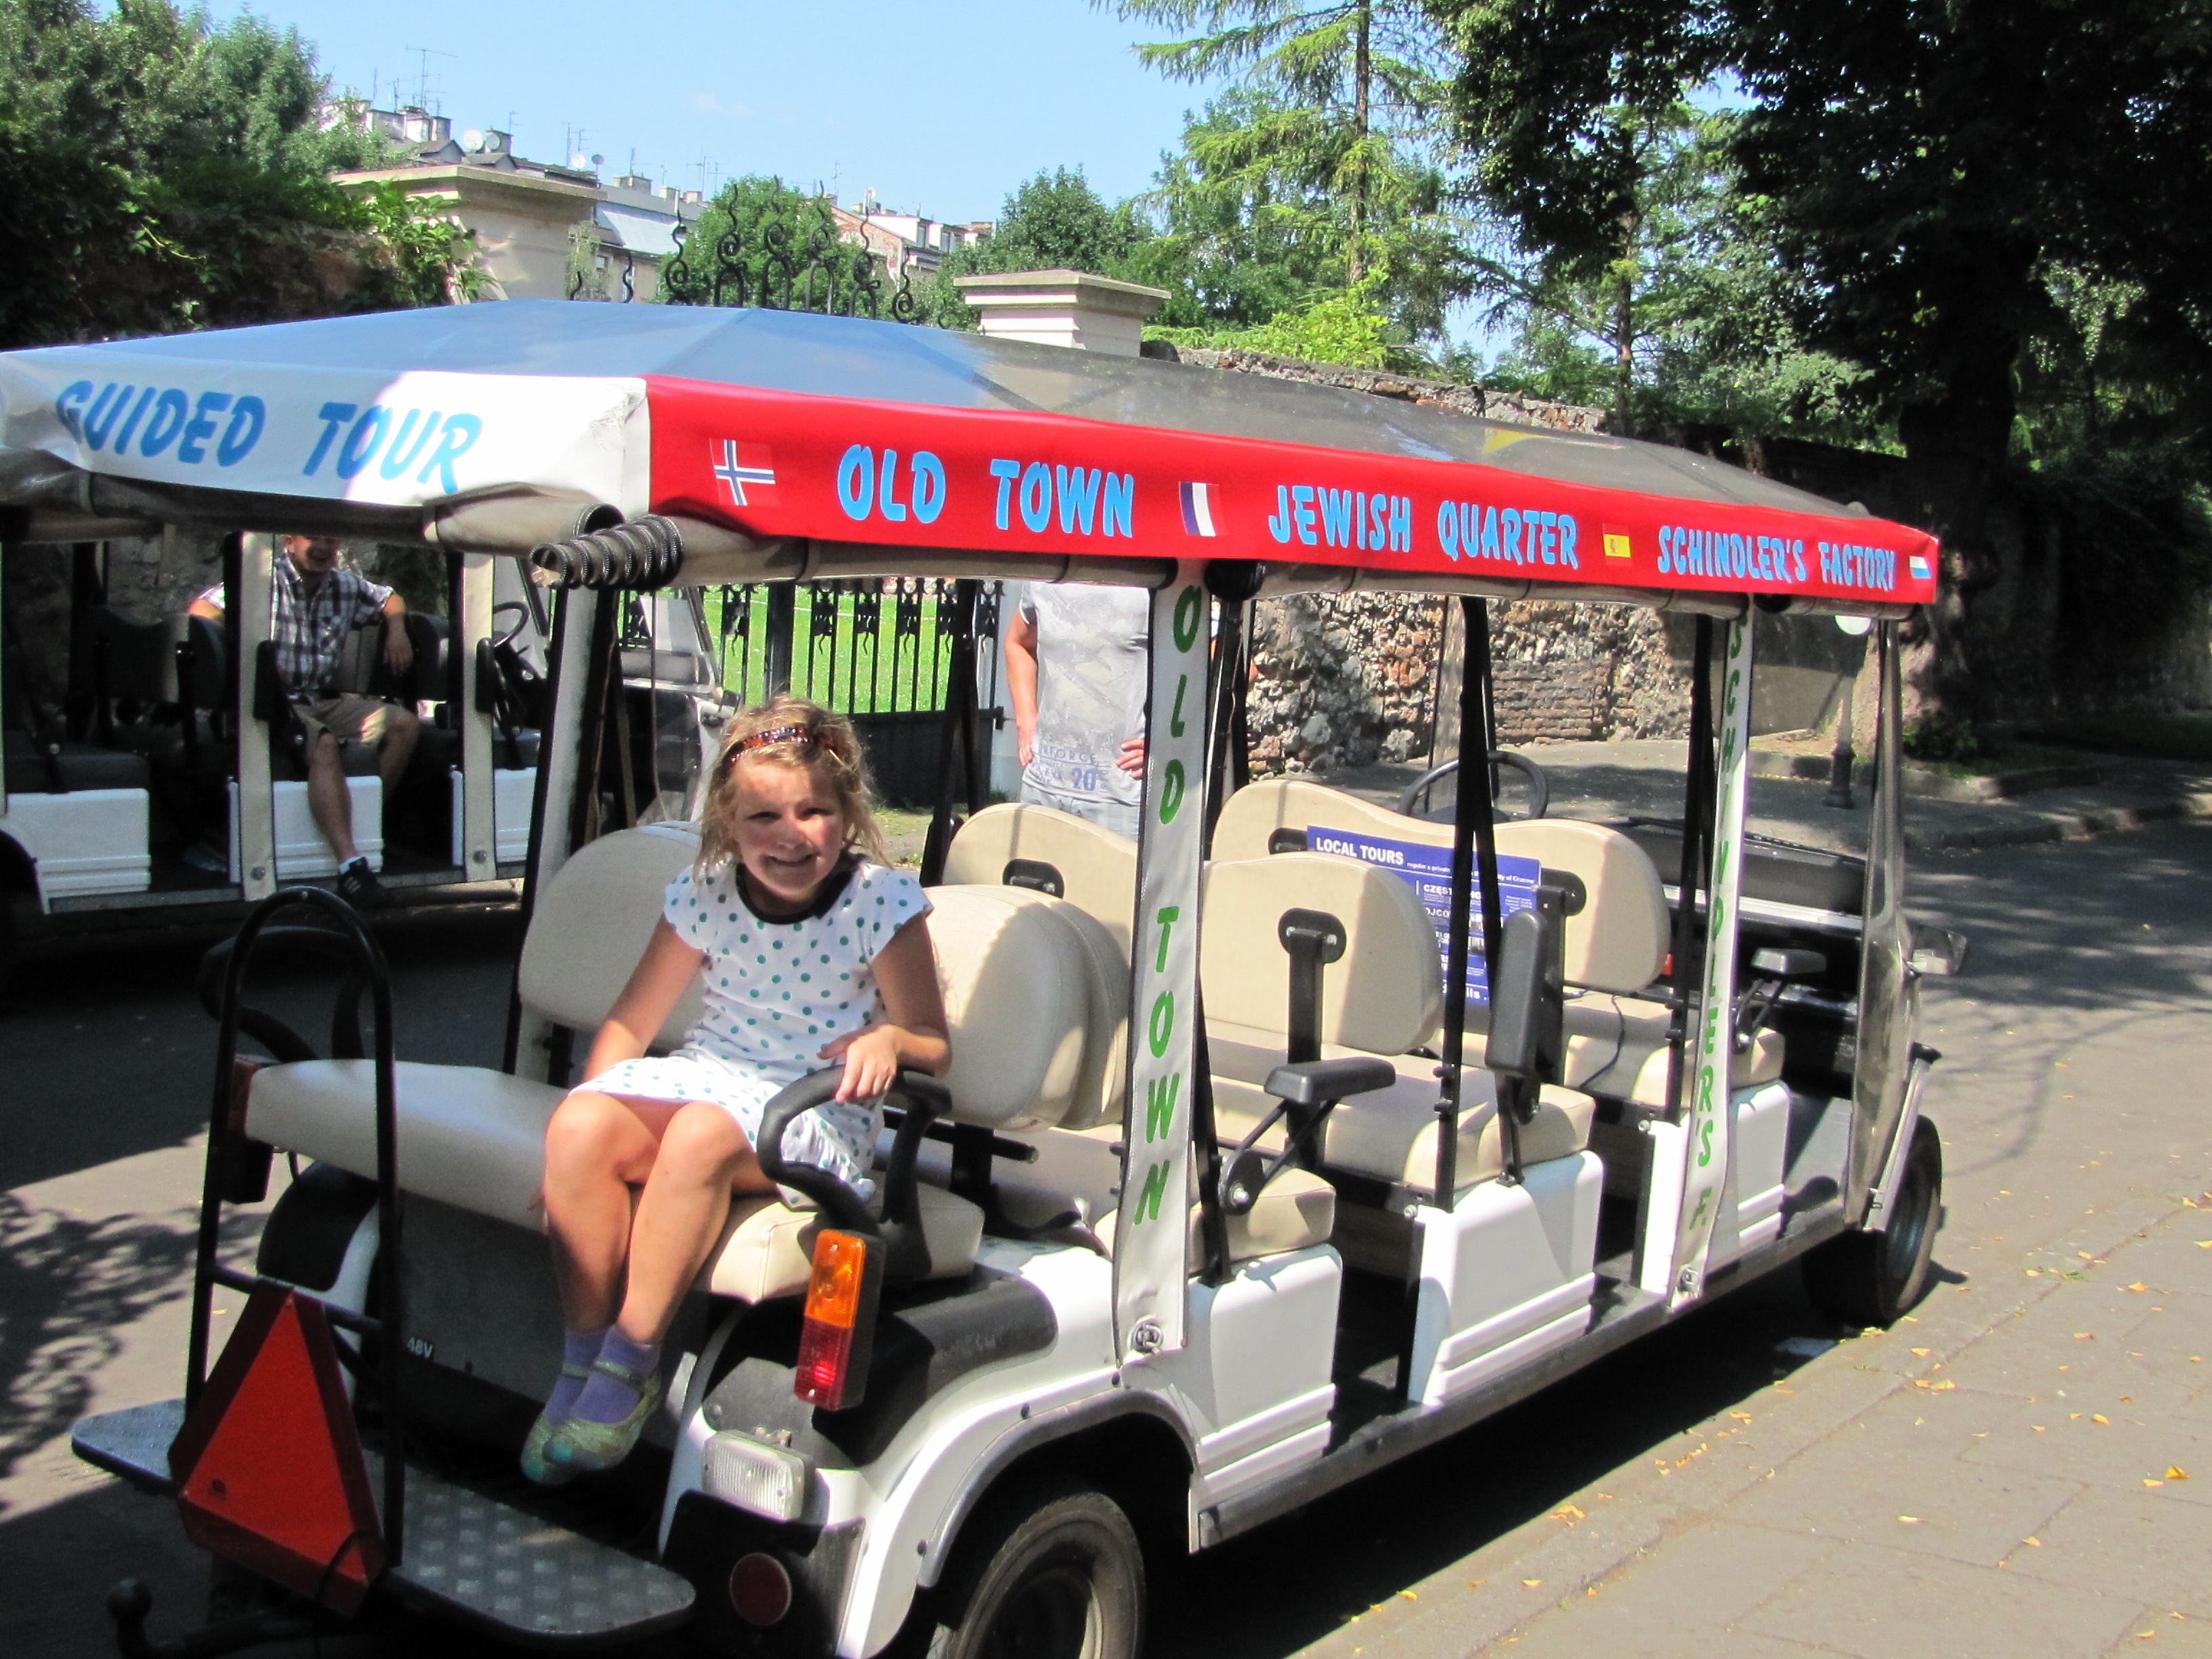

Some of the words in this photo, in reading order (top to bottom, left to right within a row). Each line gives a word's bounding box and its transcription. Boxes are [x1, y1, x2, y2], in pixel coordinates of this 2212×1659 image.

[56, 380, 266, 467] GUIDED
[304, 401, 483, 495] TOUR
[836, 444, 947, 525] OLD
[989, 458, 1134, 538] TOWN
[1268, 485, 1412, 553] JEWISH
[1437, 500, 1579, 569] QUARTER
[1657, 525, 1807, 583] SCHINDLER'S
[1818, 541, 1896, 592] FACTORY
[1160, 585, 1202, 825] OLD
[1071, 766, 1097, 792] 20
[1315, 837, 1358, 858] LOCAL
[1359, 844, 1404, 866] TOURS
[1134, 905, 1180, 1225] TOWN
[407, 1336, 434, 1359] 48V
